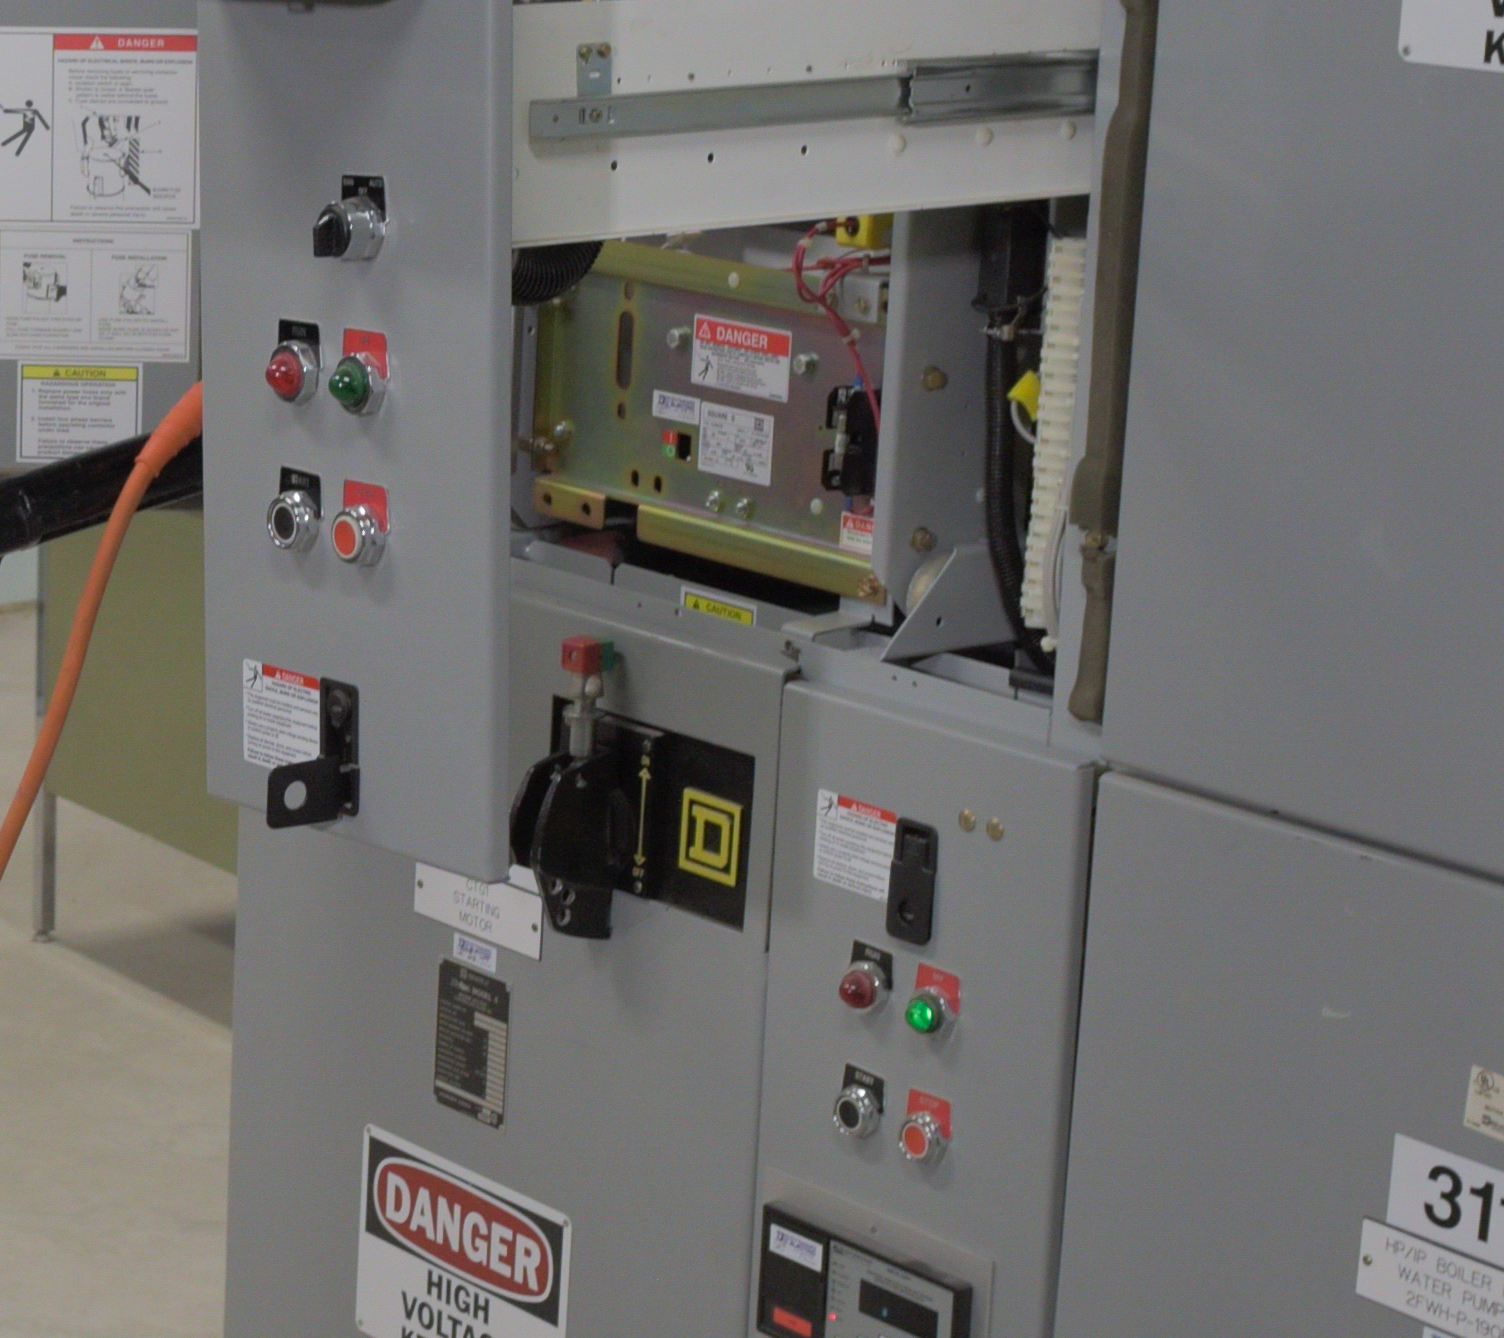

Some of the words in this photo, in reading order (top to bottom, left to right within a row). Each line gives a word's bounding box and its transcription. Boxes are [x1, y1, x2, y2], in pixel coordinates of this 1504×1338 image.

[117, 38, 164, 48] DANGER
[715, 325, 769, 350] DANGER
[65, 369, 106, 378] CAUTION
[854, 517, 874, 533] DAN
[706, 602, 742, 621] CAUTION
[282, 672, 304, 686] DANGER
[453, 890, 500, 920] STARTING
[458, 909, 493, 933] MOTOR
[855, 1071, 875, 1087] START
[385, 1170, 543, 1293] DANGER
[1385, 1237, 1427, 1263] HP/IP
[1435, 1256, 1492, 1293] BOILER
[1398, 1263, 1452, 1299] WATER
[426, 1268, 491, 1324] HIGH
